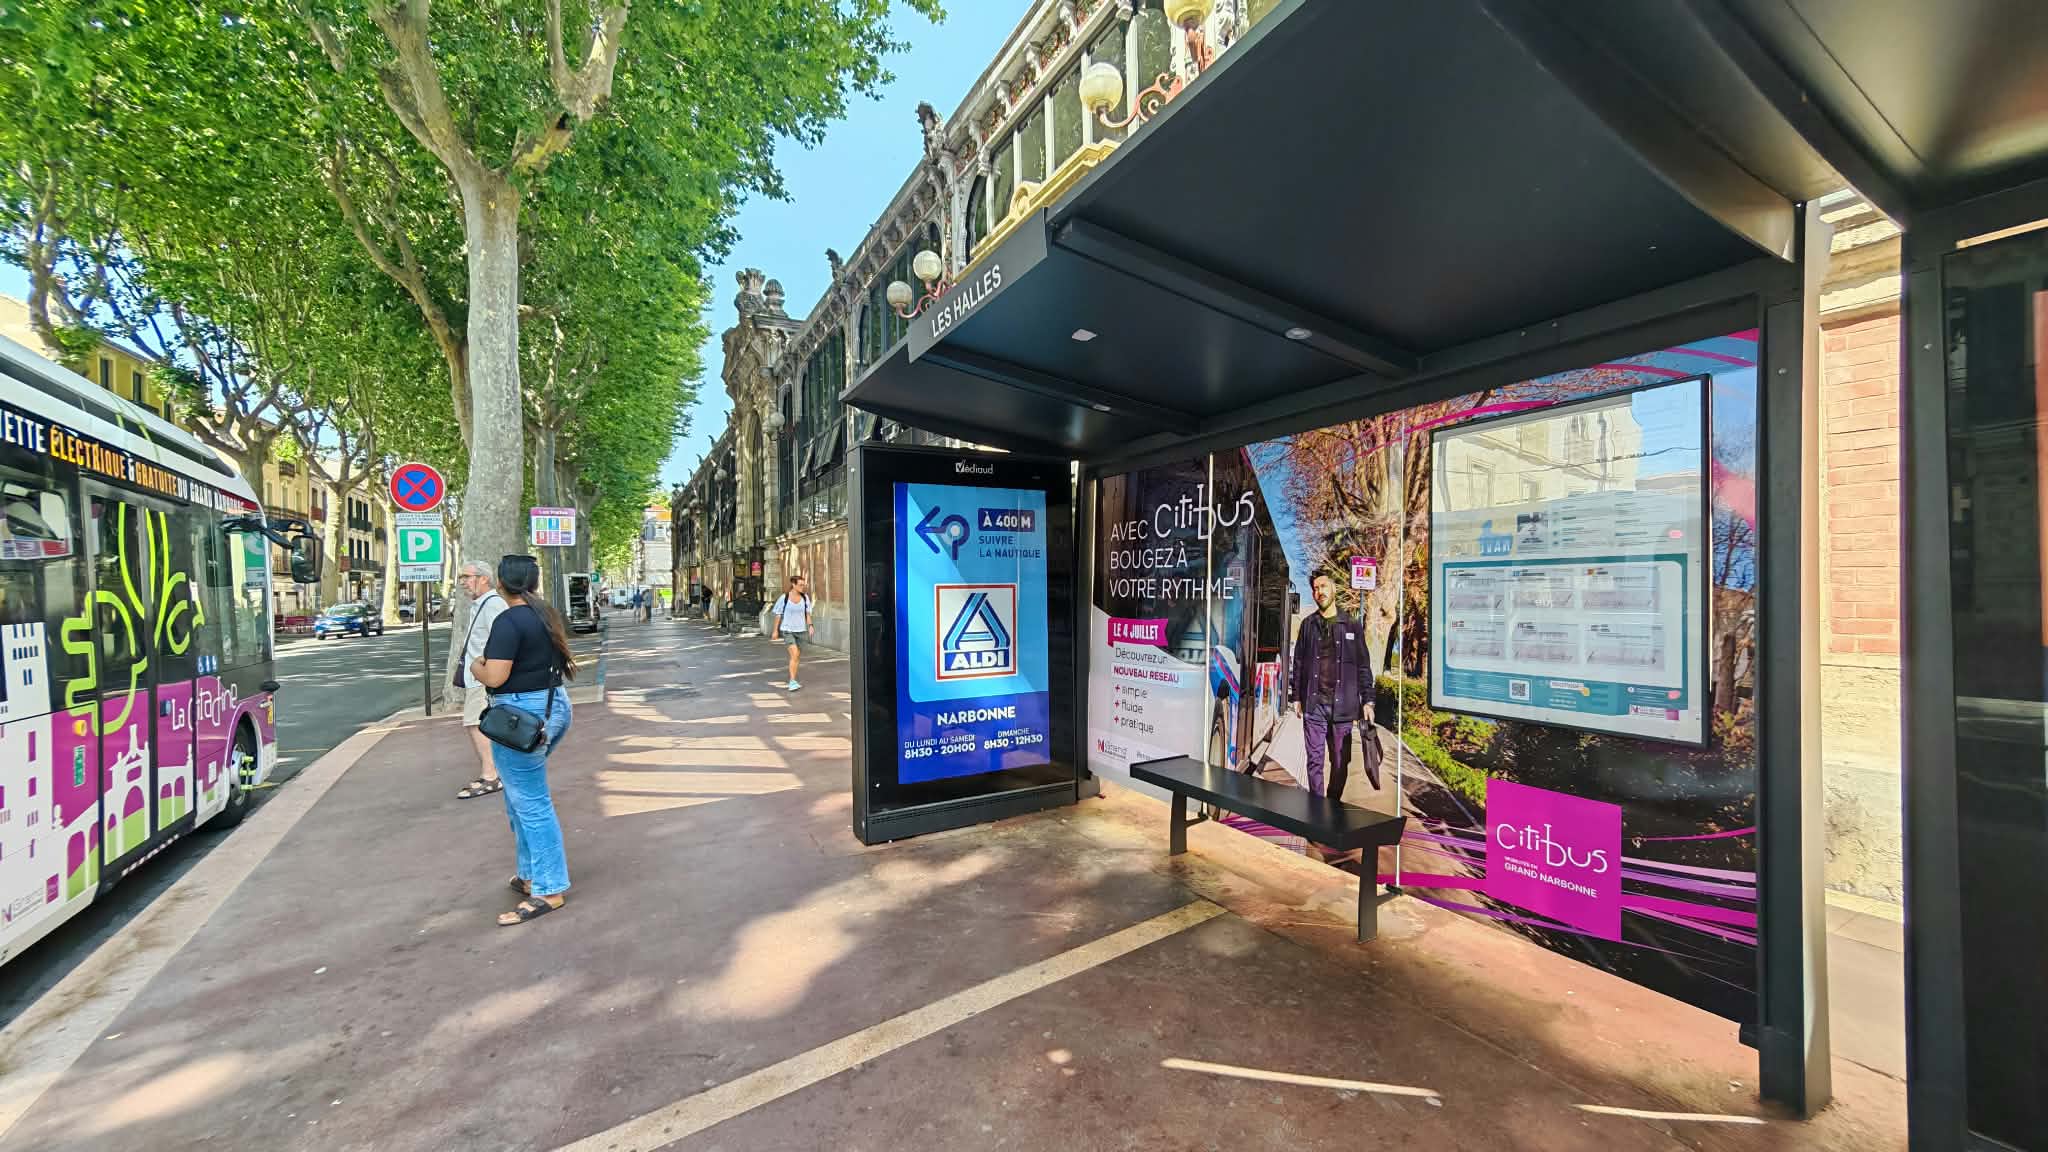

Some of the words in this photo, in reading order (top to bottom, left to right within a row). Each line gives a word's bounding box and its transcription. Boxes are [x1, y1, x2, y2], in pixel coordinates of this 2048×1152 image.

[932, 306, 951, 338] LES
[953, 264, 1001, 321] HALLES
[0, 409, 47, 453] ETTE
[135, 462, 178, 497] GRATUITE
[177, 478, 188, 500] DU
[189, 482, 213, 509] GRAND
[983, 511, 992, 527] À
[995, 515, 1018, 528] 400
[1020, 516, 1031, 528] M
[978, 535, 1015, 545] SUIVRE
[1111, 519, 1149, 542] AVEC
[407, 531, 433, 561] P
[980, 548, 992, 558] LA
[994, 548, 1041, 559] NAUTIQUE
[1110, 547, 1175, 569] BOUGEZ
[1176, 541, 1188, 568] À
[1109, 578, 1157, 599] VOTRE
[1161, 577, 1234, 600] RYTHME
[1113, 623, 1122, 637] LE
[1123, 623, 1128, 638] 4
[1129, 624, 1159, 641] JUILLET
[951, 650, 1005, 670] ALDI
[1113, 666, 1148, 679] NOUVEAU
[172, 698, 185, 731] La
[937, 706, 1016, 726] NARBONNE
[997, 728, 1030, 738] DIMANCHE
[1120, 717, 1154, 734] pratique
[904, 741, 915, 749] DU
[916, 738, 938, 748] LUNDI
[939, 736, 949, 745] AU
[950, 734, 975, 744] SAMEDI
[904, 747, 933, 759] 8H30
[940, 742, 976, 755] 20H00
[983, 738, 1009, 749] 8H30
[1015, 734, 1043, 745] 12H30
[1504, 862, 1538, 879] GRAND
[1539, 873, 1598, 898] NARBONNE
